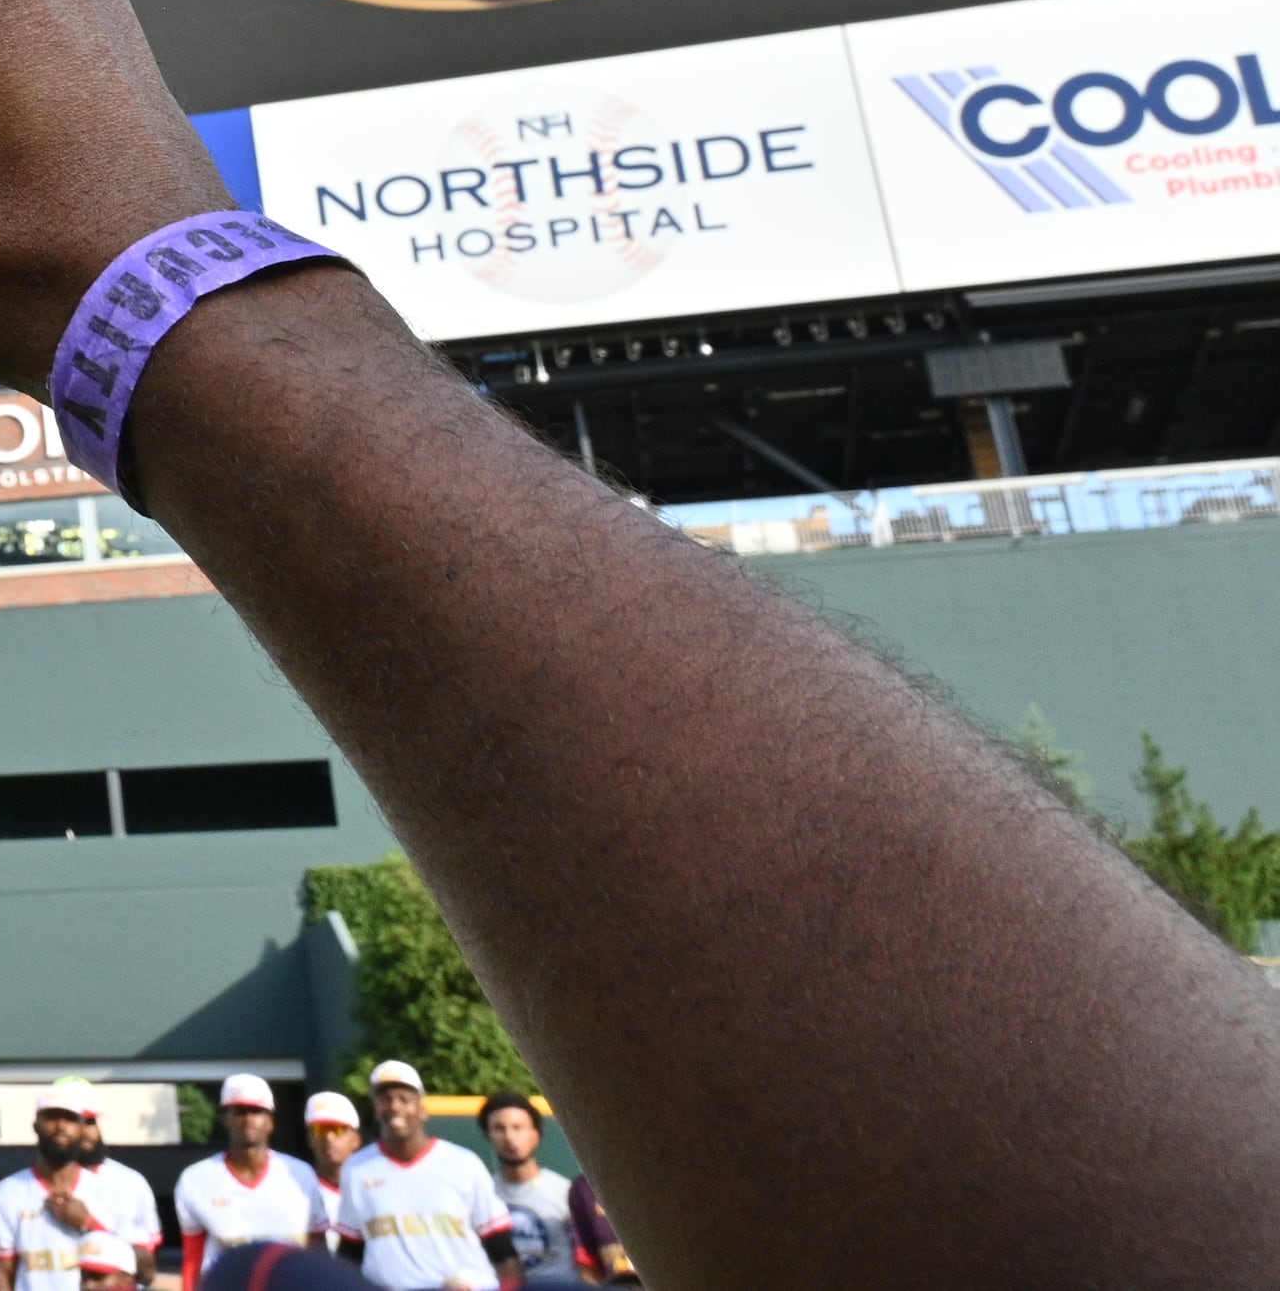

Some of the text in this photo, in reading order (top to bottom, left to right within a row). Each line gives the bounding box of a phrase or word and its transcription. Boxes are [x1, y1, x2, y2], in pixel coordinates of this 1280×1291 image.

[315, 126, 814, 226] NORTHSIDE
[1125, 144, 1257, 174] Cooling
[410, 203, 727, 263] HOSPITAL
